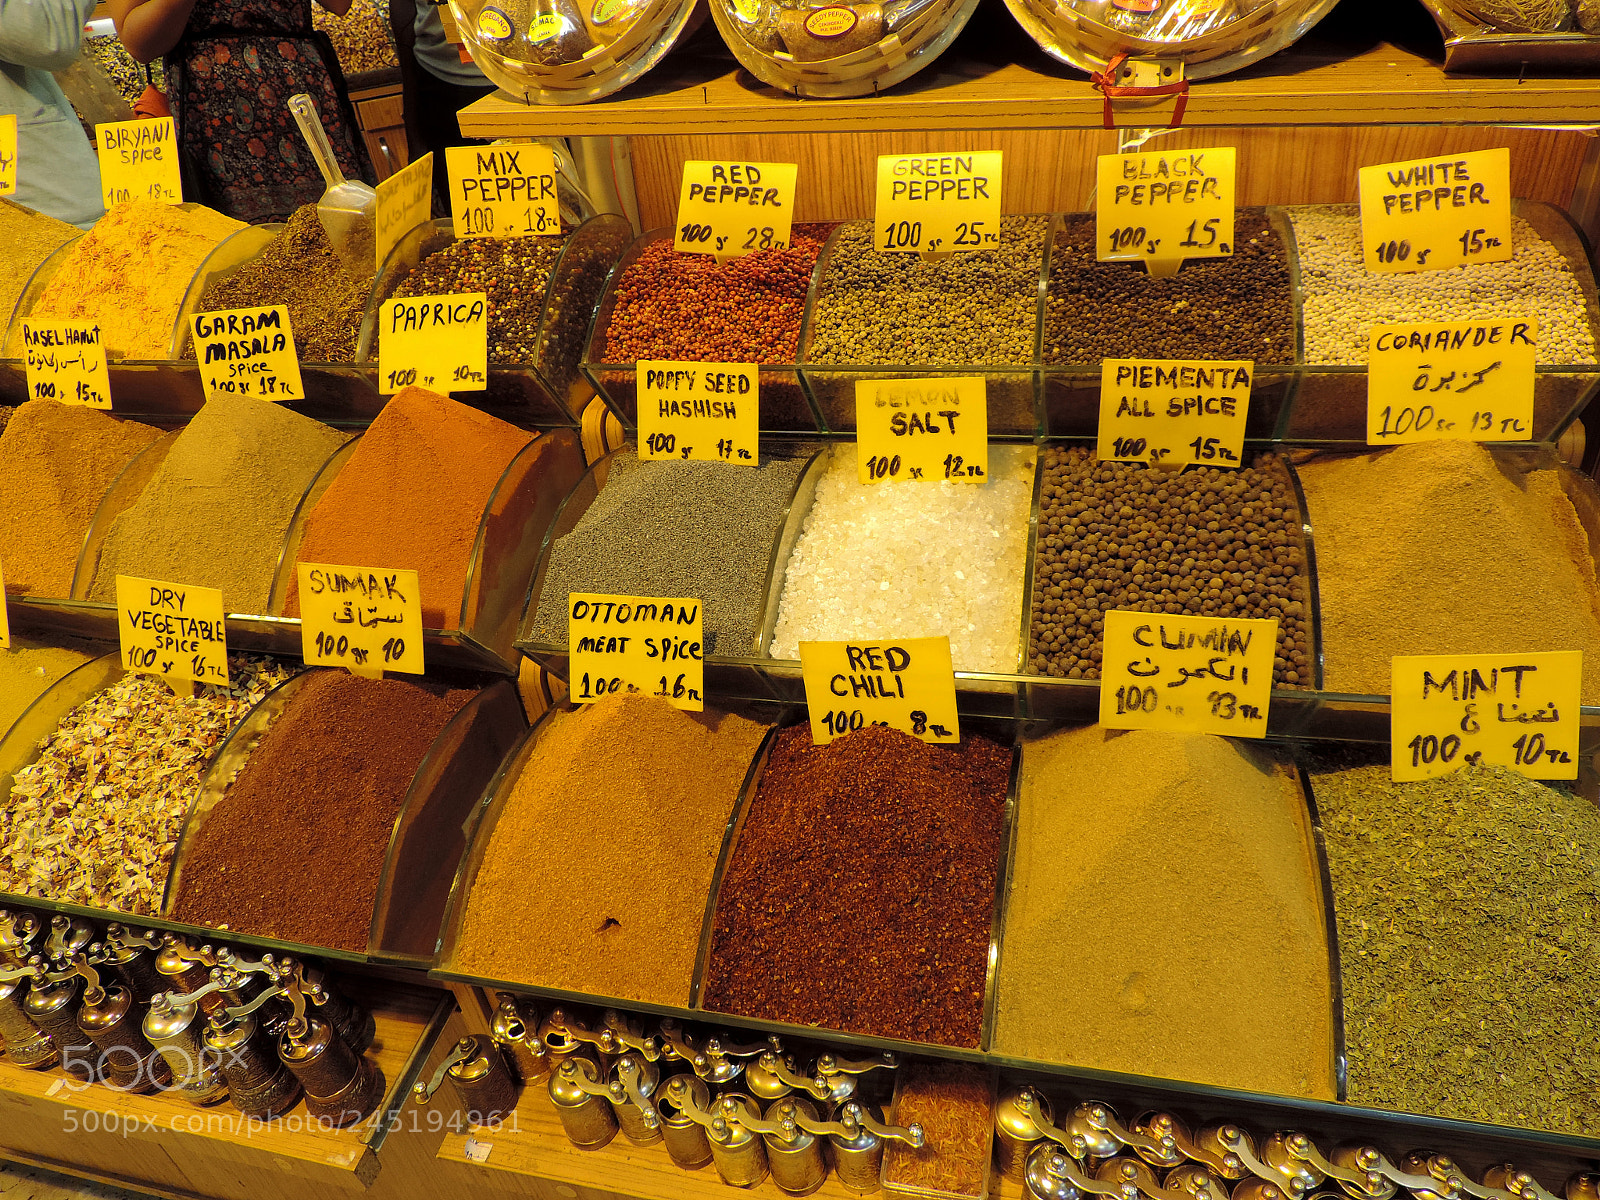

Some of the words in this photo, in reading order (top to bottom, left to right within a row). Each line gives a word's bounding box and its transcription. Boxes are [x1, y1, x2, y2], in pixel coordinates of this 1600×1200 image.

[480, 12, 508, 32] OREGANO
[530, 17, 554, 31] SUMAC
[828, 10, 852, 22] PEPPER
[105, 121, 170, 150] BIRYANI
[477, 150, 523, 175] MIX
[712, 165, 761, 185] RED
[893, 156, 972, 177] GREEN
[1123, 154, 1204, 181] BLACK
[1387, 161, 1470, 188] WHITE
[462, 174, 556, 202] PEPPER
[689, 183, 782, 207] PEPPER
[892, 177, 990, 201] PEPPER
[1115, 177, 1221, 206] PEPPER
[1383, 183, 1490, 215] PEPPER
[461, 207, 494, 235] 100
[681, 223, 713, 243] 100
[715, 236, 729, 251] gr
[883, 221, 922, 249] 100
[927, 238, 943, 252] gr
[1109, 226, 1147, 252] 100
[1376, 239, 1411, 263] 100
[1416, 249, 1432, 265] gr
[195, 309, 281, 338] GARAM
[392, 300, 484, 333] PAPRICA
[205, 333, 286, 365] MASALA
[1377, 323, 1536, 353] CORIANDER
[35, 382, 56, 398] 100
[388, 368, 417, 389] 100
[646, 369, 696, 391] POPPY
[705, 372, 750, 395] SEED
[1116, 366, 1250, 389] PIEMENTA
[659, 398, 736, 419] HASHISH
[1116, 396, 1155, 418] ALL
[1166, 395, 1237, 417] SPICE
[890, 410, 961, 436] SALT
[1376, 406, 1435, 438] 100
[646, 433, 675, 456] 100
[681, 446, 693, 460] gr
[1112, 436, 1147, 457] 100
[1150, 448, 1171, 464] gr
[866, 455, 901, 480] 100
[150, 587, 186, 612] DRY
[310, 569, 406, 604] SUMAK
[572, 600, 697, 625] OTTOMAN
[128, 609, 224, 643] VEGETABLE
[155, 635, 200, 653] SPICE
[316, 631, 348, 658] 100
[382, 637, 405, 663] 10
[577, 636, 631, 653] MEAT
[1133, 625, 1253, 656] CUMIN
[128, 645, 157, 668] 100
[846, 645, 911, 672] RED
[579, 672, 622, 698] 100
[830, 674, 905, 698] CHILI
[1423, 665, 1537, 701] MINT
[1115, 685, 1158, 715] 100
[821, 710, 864, 735] 100
[1408, 734, 1461, 767] 100
